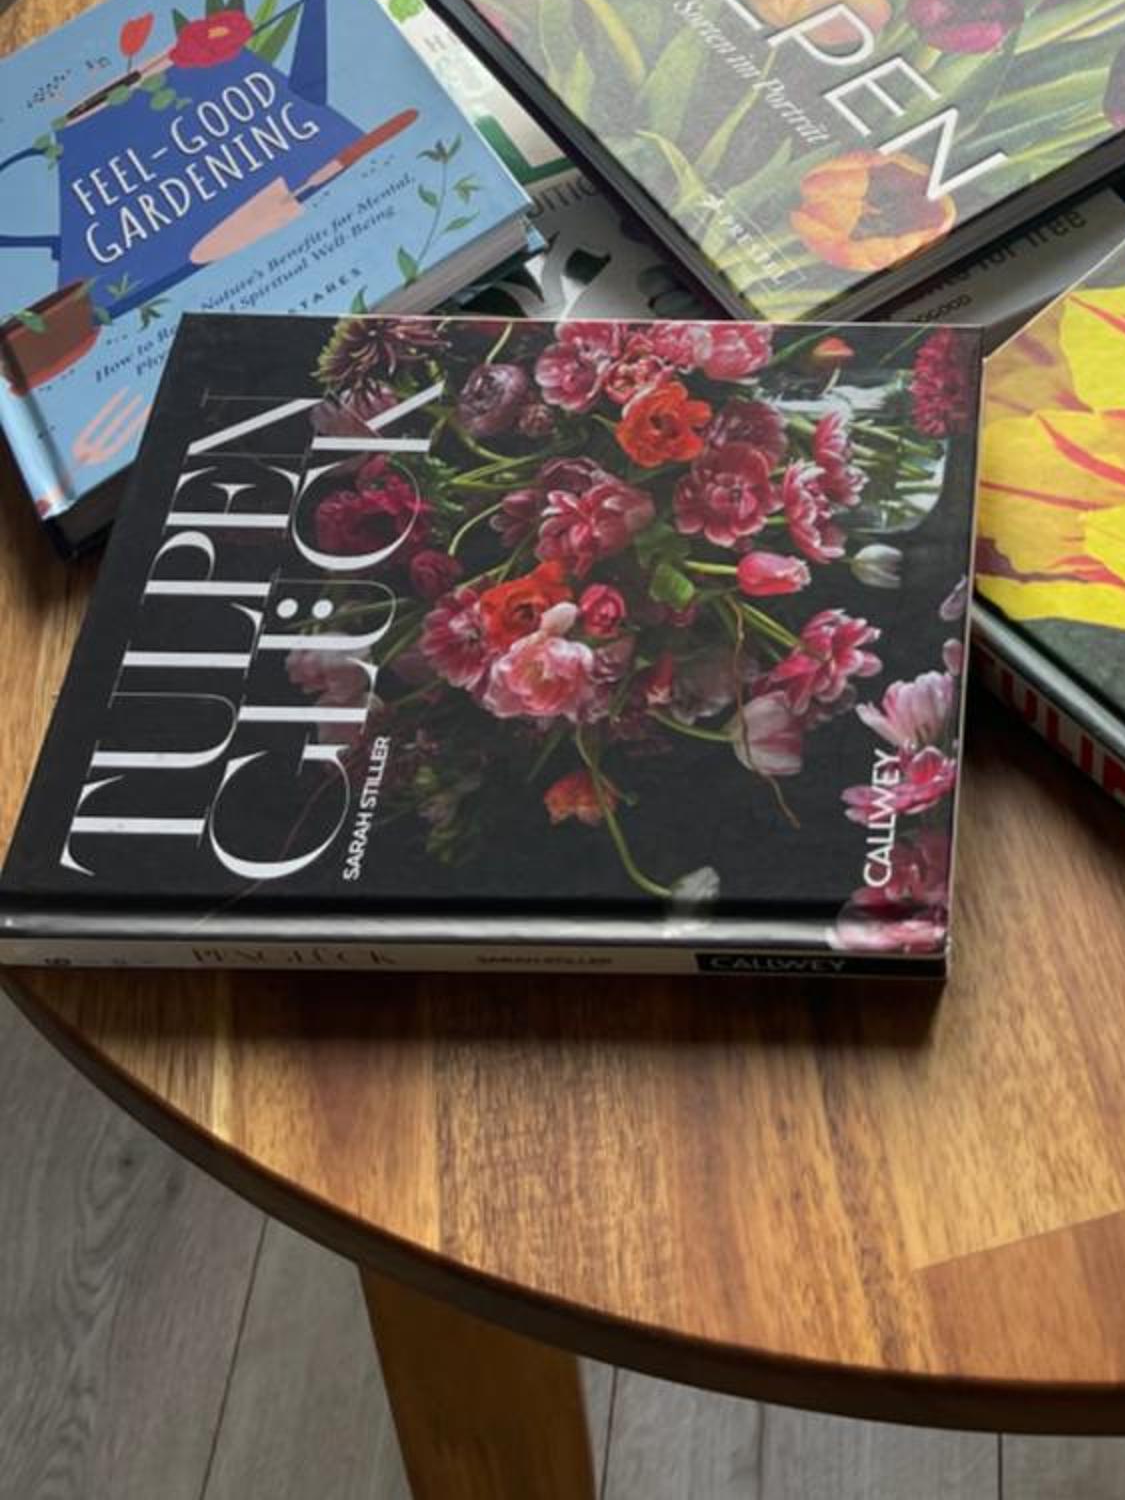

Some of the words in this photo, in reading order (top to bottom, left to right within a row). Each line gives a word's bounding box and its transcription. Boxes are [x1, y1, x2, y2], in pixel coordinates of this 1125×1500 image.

[71, 71, 276, 216] FEEL-GOOD
[672, 0, 737, 54] Sorten
[725, 53, 761, 80] im
[752, 77, 831, 143] Porträt
[85, 101, 320, 264] GARDENING
[95, 353, 135, 383] How
[267, 227, 330, 272] Benefits
[330, 210, 353, 233] for
[239, 260, 309, 308] Spiritual
[59, 387, 325, 877] TULPEN
[208, 379, 446, 881] GLÜCK
[343, 808, 376, 882] SARAH
[360, 735, 393, 808] STILLER
[862, 748, 901, 888] CALLWEY
[710, 954, 847, 972] CALLWEY
